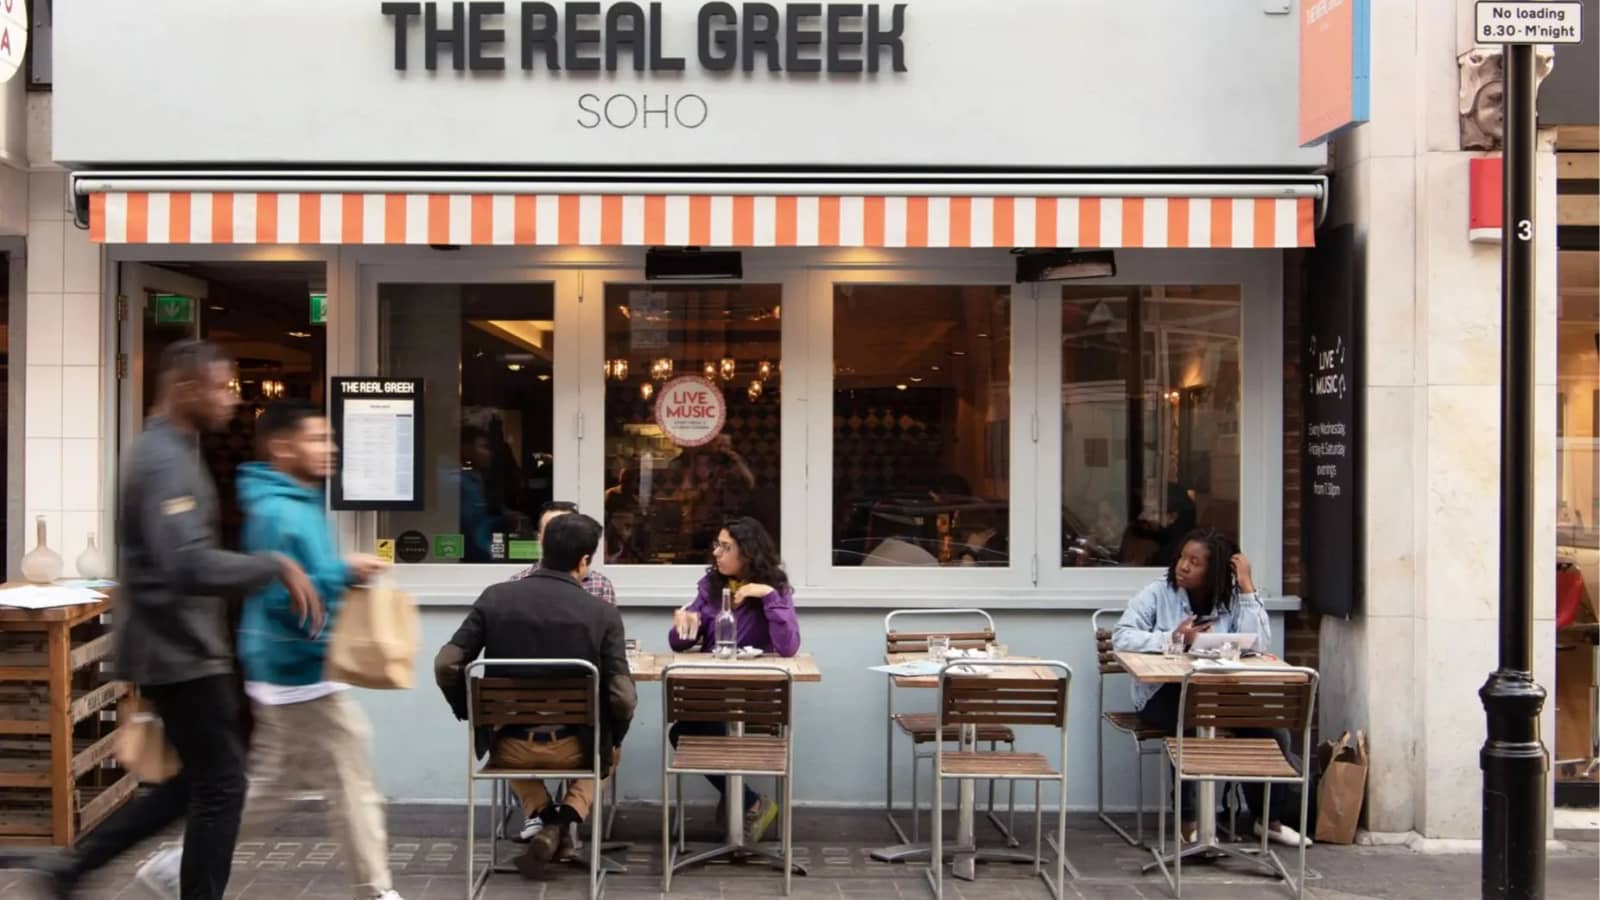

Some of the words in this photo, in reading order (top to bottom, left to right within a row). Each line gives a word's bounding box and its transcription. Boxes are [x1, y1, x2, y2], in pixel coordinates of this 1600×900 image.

[1492, 7, 1512, 19] No
[1516, 7, 1565, 21] loading
[381, 2, 505, 71] THE
[521, 2, 686, 71] REAL
[697, 1, 908, 73] GREEK
[1483, 25, 1516, 37] 8.30
[1525, 25, 1575, 39] M'night
[577, 93, 708, 129] SOHO
[1517, 219, 1532, 241] 3
[1319, 349, 1335, 371] LIVE
[341, 382, 359, 393] THE
[360, 382, 383, 393] REAL
[384, 382, 414, 393] GREEK
[1316, 373, 1338, 396] MUSIC
[673, 391, 707, 404] LIVE
[666, 405, 716, 418] MUSIC
